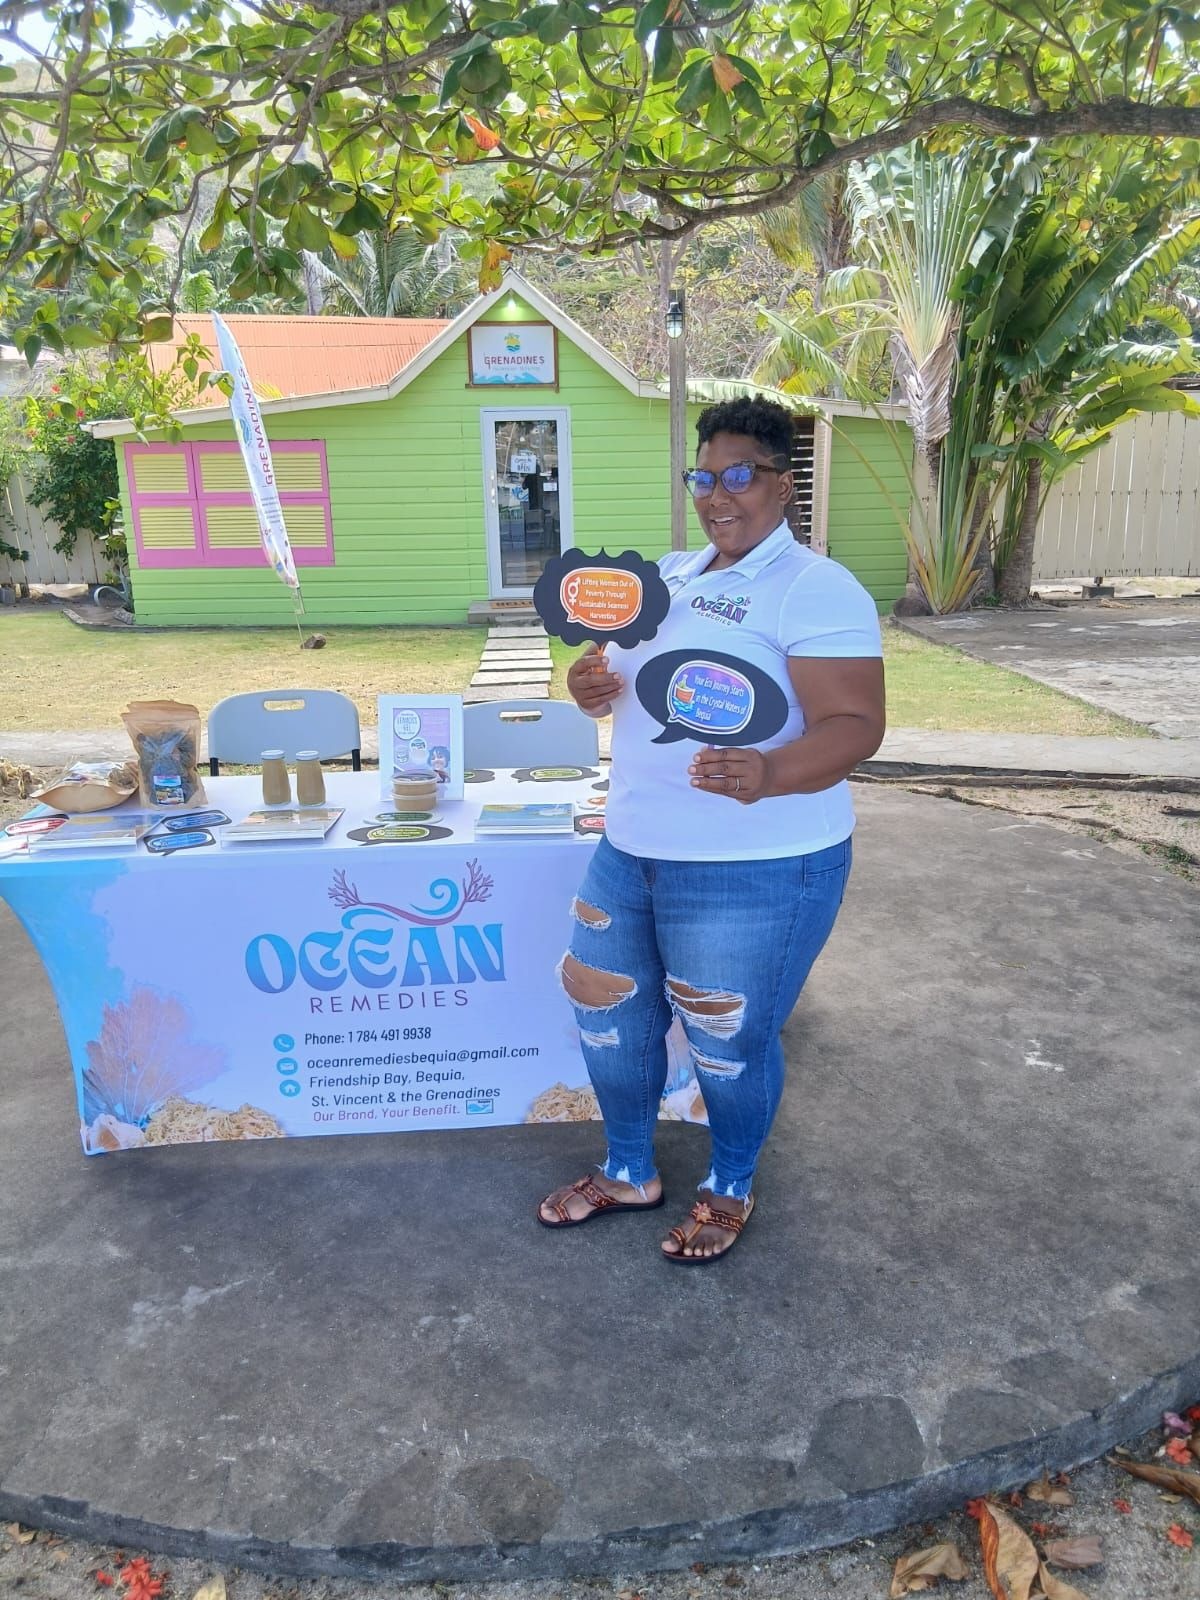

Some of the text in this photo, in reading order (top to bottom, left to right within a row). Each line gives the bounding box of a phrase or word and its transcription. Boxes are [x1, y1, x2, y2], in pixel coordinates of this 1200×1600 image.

[484, 356, 545, 367] GRENADINES
[238, 368, 273, 486] GRENADINES
[582, 578, 599, 587] Lifting
[600, 579, 618, 587] Women
[579, 600, 607, 608] Sustainable
[585, 590, 627, 599] Poverty Through
[590, 612, 617, 621] Harvesting
[691, 596, 748, 624] OCEAN
[695, 675, 745, 697] Your Eco Journey Starts
[695, 707, 712, 721] Bequia
[709, 697, 725, 710] Crystal
[724, 700, 740, 714] Waters
[740, 705, 747, 715] of
[245, 924, 507, 994] OCEAN
[310, 989, 470, 1014] REMEDIES
[304, 1027, 432, 1045] Phone: 1 784 491 9938
[307, 1046, 540, 1069] oceanremediesbequia@gmail.com
[309, 1068, 466, 1088] Friendship Bay, Bequia,
[311, 1086, 501, 1107] St. Vincent & the Grenadines
[313, 1103, 461, 1122] Our Brand, Your Benefit.
